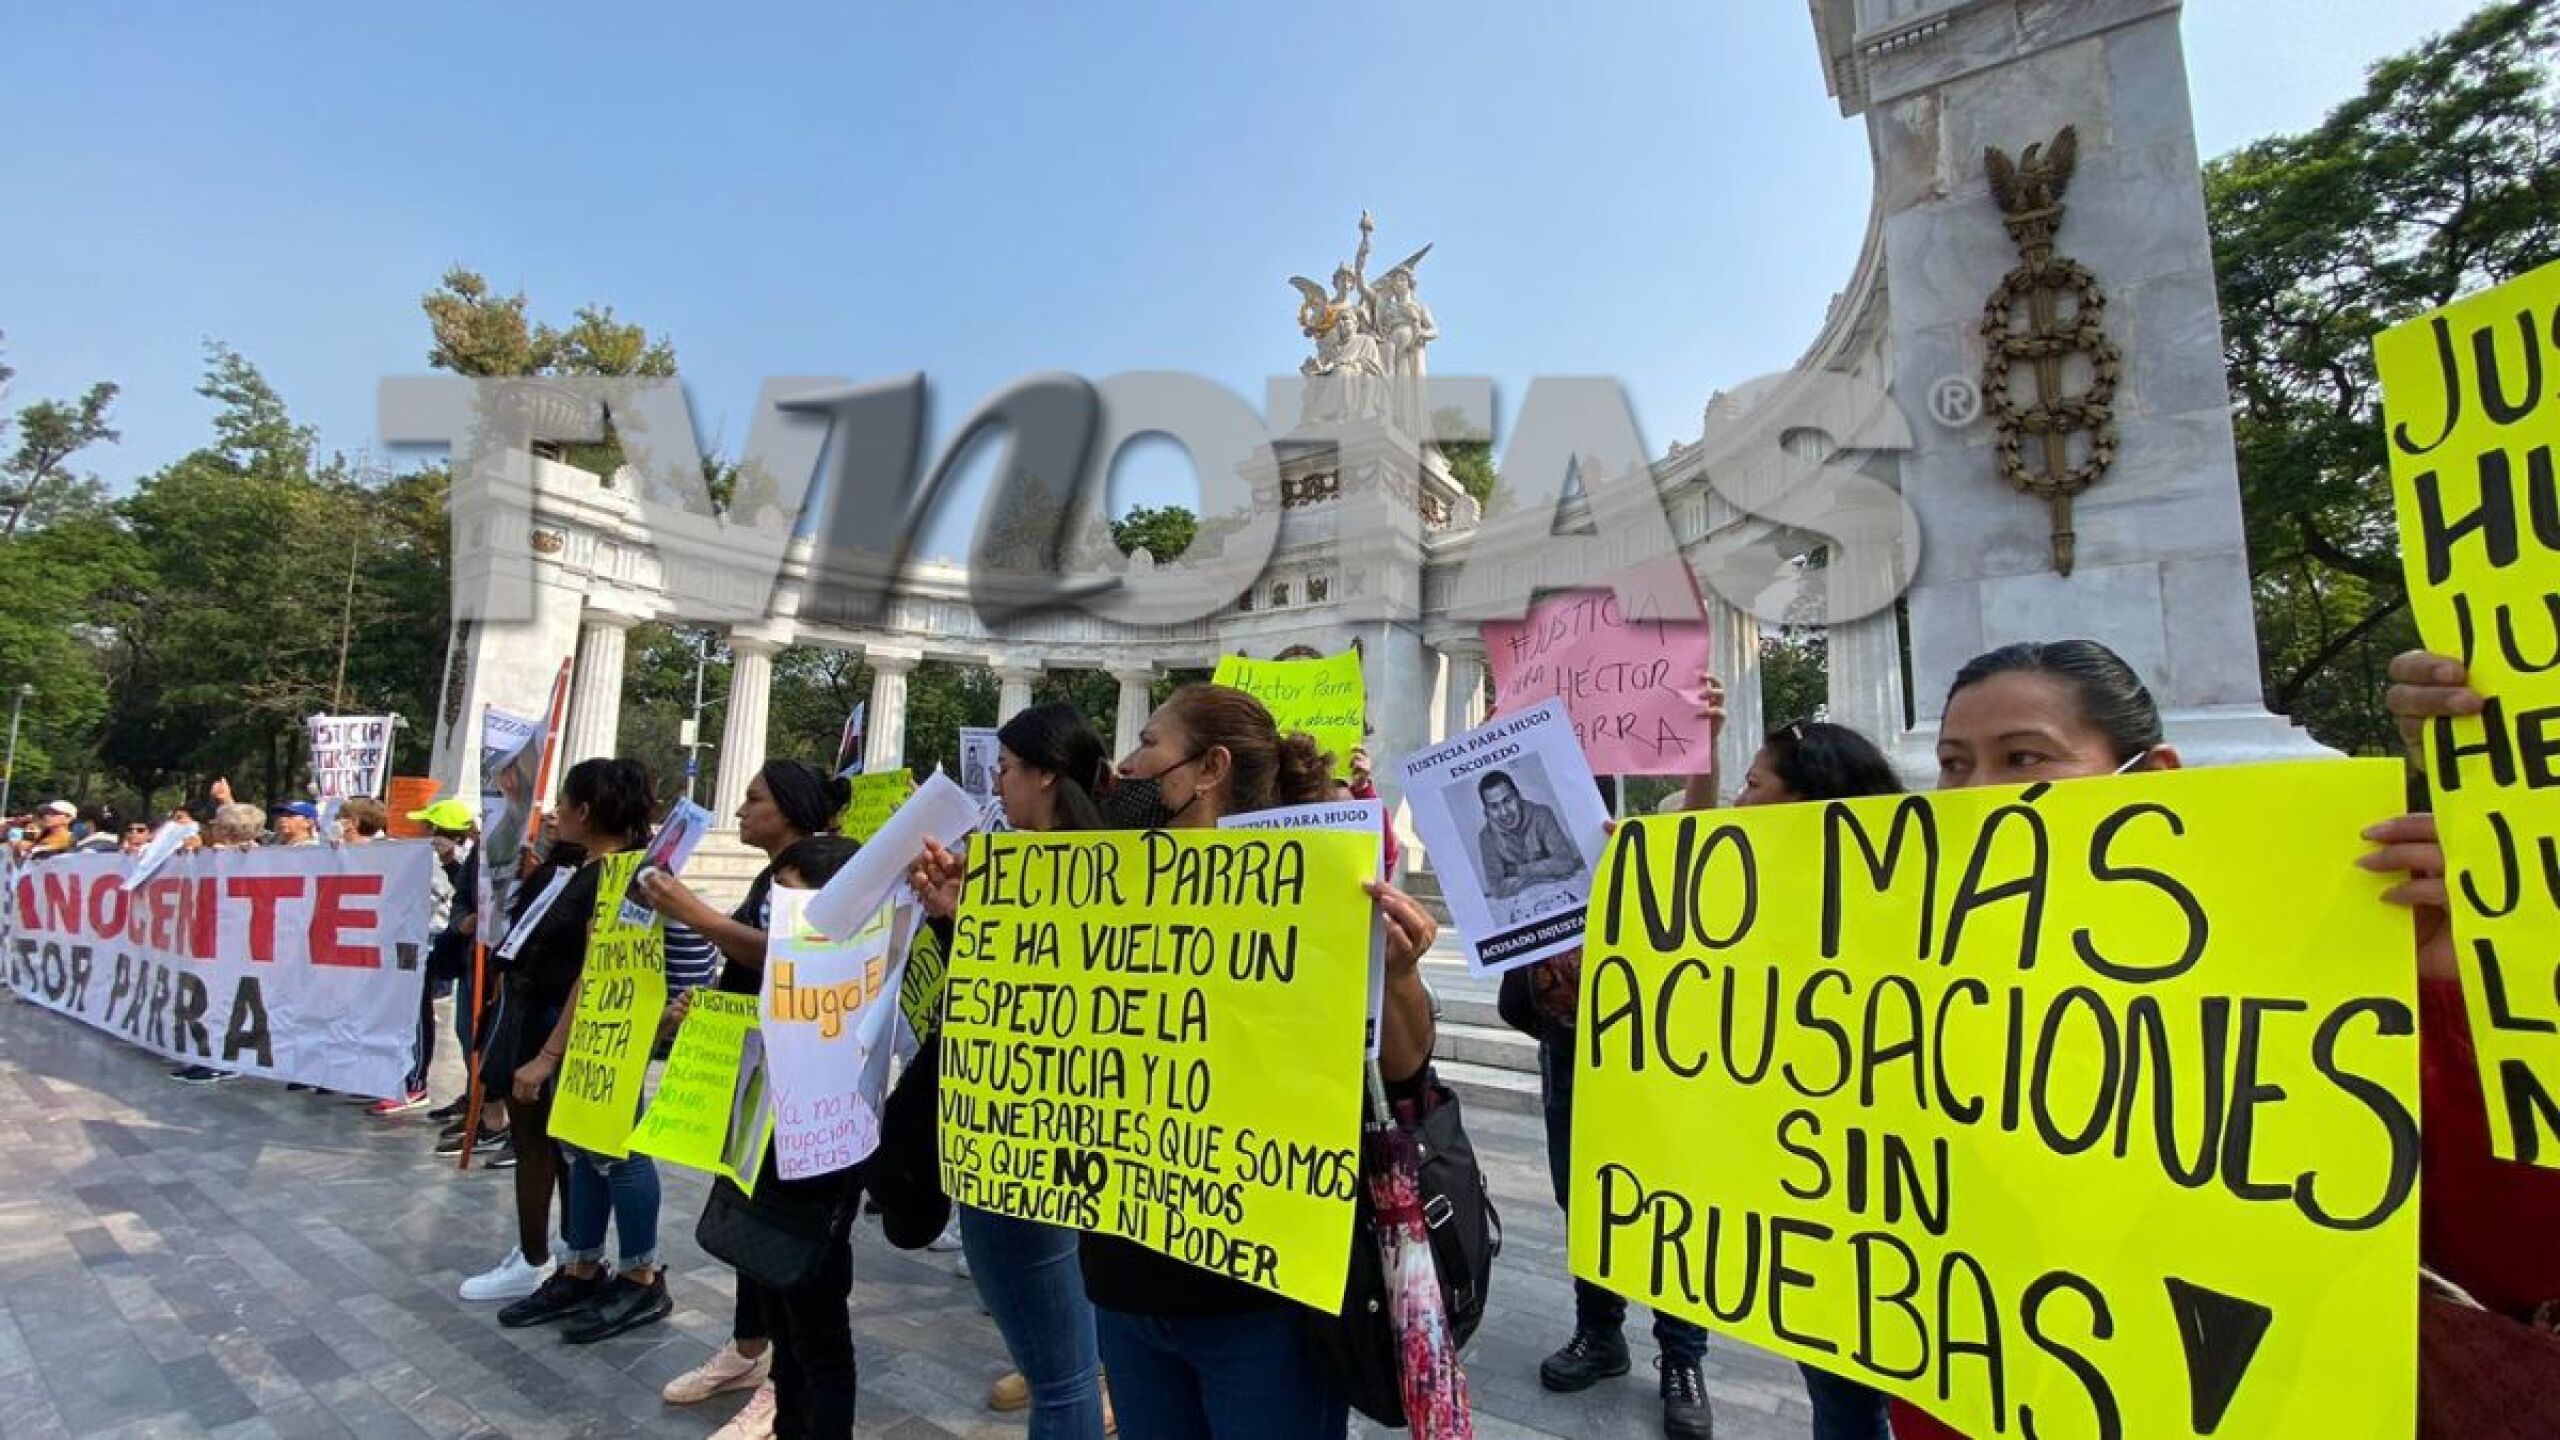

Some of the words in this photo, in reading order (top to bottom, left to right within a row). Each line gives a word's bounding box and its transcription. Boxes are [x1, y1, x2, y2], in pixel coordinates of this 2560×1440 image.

[2394, 303, 2560, 457] JU
[1555, 655, 1682, 712] HÉCTOR
[1407, 744, 1466, 777] JUSTICIA
[1468, 728, 1505, 752] PARA
[1509, 709, 1552, 735] HUGO
[1450, 742, 1522, 779] ESCOBEDO
[1284, 814, 1320, 829] PARA
[1325, 809, 1369, 825] HUGO
[960, 833, 1126, 910] HECTOR
[1141, 830, 1306, 910] PARRA
[1604, 815, 1758, 953] NO
[1821, 781, 2208, 983] MÁS
[955, 914, 1001, 962] SE
[1013, 921, 1060, 968] HA
[1081, 922, 1216, 976] VUELTO
[1228, 925, 1298, 983] UN
[1480, 931, 1537, 961] ACUSADO
[104, 952, 273, 1068] PARRA
[773, 961, 861, 1038] Hugo
[943, 978, 1078, 1039] ESPEJO
[1091, 985, 1149, 1037] DE
[1157, 988, 1209, 1043] LA
[941, 1037, 1126, 1100] INJUSTICIA
[1142, 1052, 1160, 1106] Y
[1166, 1058, 1211, 1114] LO
[1590, 954, 2422, 1231] ACUSACIONES
[940, 1087, 1151, 1156] VULNERABLES
[1159, 1117, 1225, 1174] QUE
[1235, 1128, 1358, 1201] SOMOS
[942, 1126, 983, 1171] LOS
[989, 1140, 1046, 1183] QUE
[1053, 1147, 1109, 1196] NO
[1114, 1157, 1245, 1225] TENEMOS
[1777, 1110, 1949, 1237] SIN
[940, 1162, 1100, 1230] INFLUENCIAS
[1116, 1199, 1149, 1242] NI
[1163, 1210, 1281, 1291] PODER
[1595, 1163, 2123, 1440] PRUEBAS
